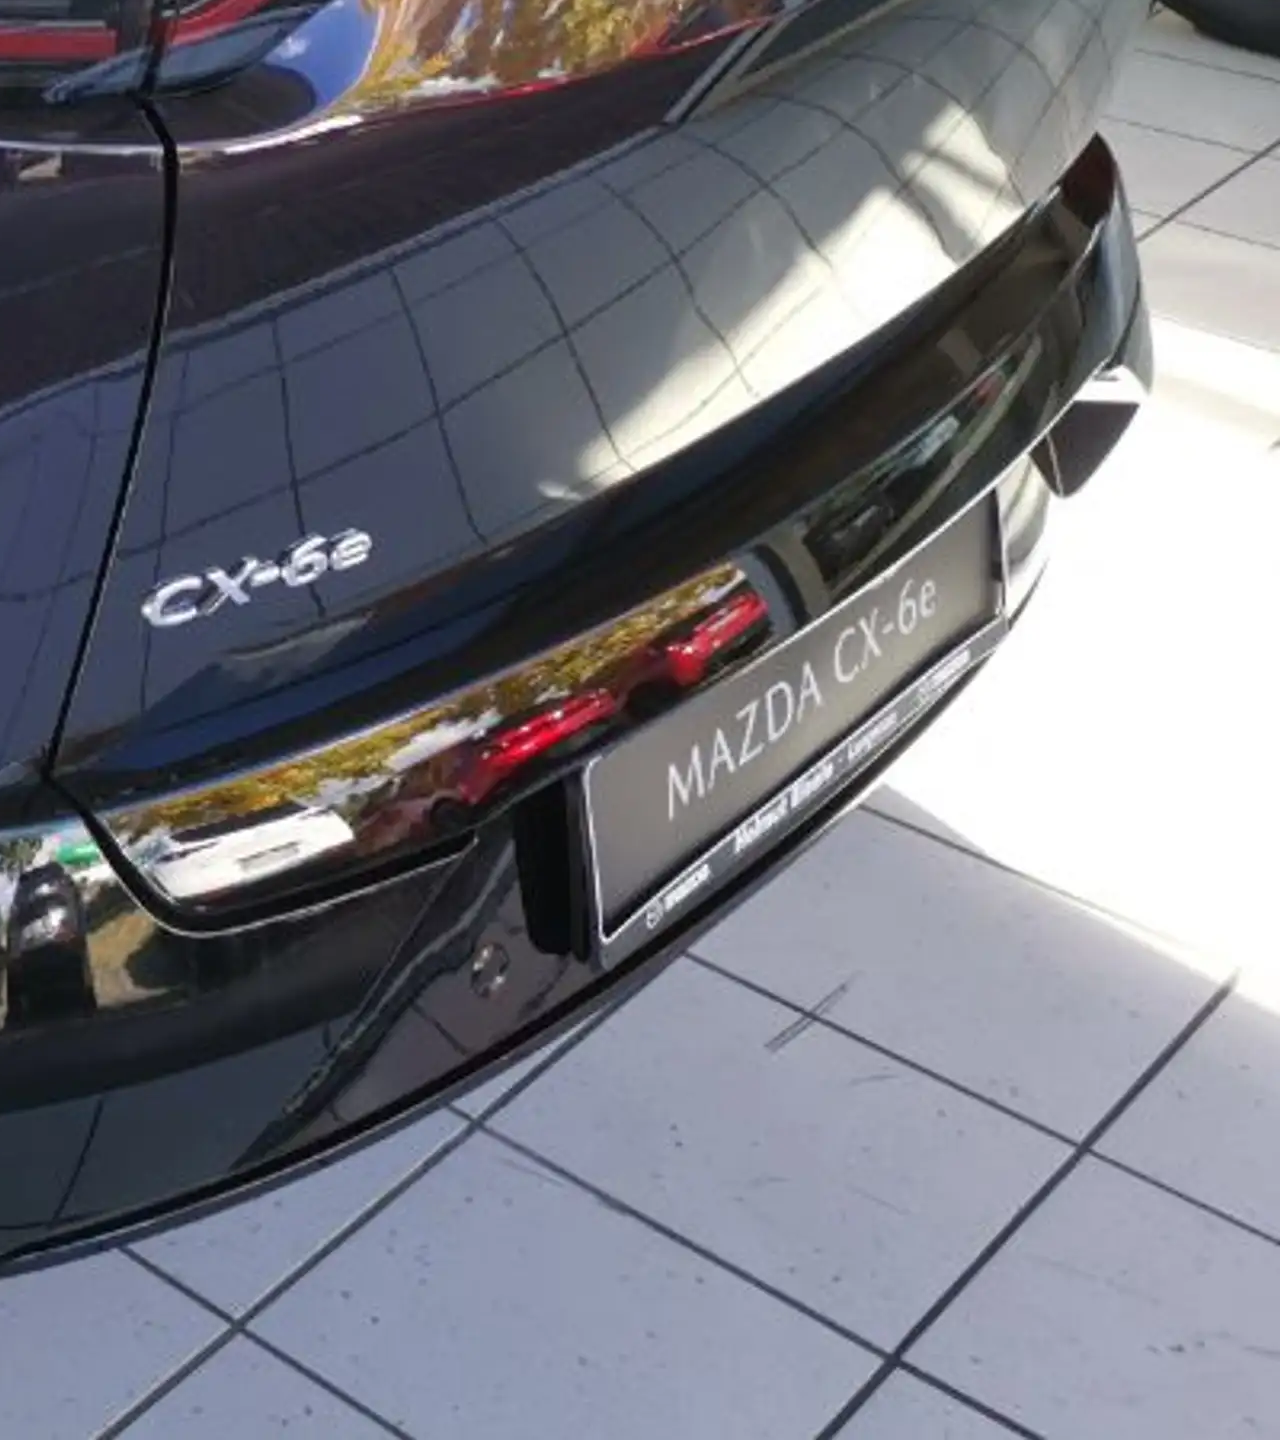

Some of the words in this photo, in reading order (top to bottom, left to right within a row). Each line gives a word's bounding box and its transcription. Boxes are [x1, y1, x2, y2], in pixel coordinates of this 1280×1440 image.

[140, 527, 373, 627] CX-6e
[666, 661, 826, 822] MAZDA
[833, 575, 939, 684] CX-6e
